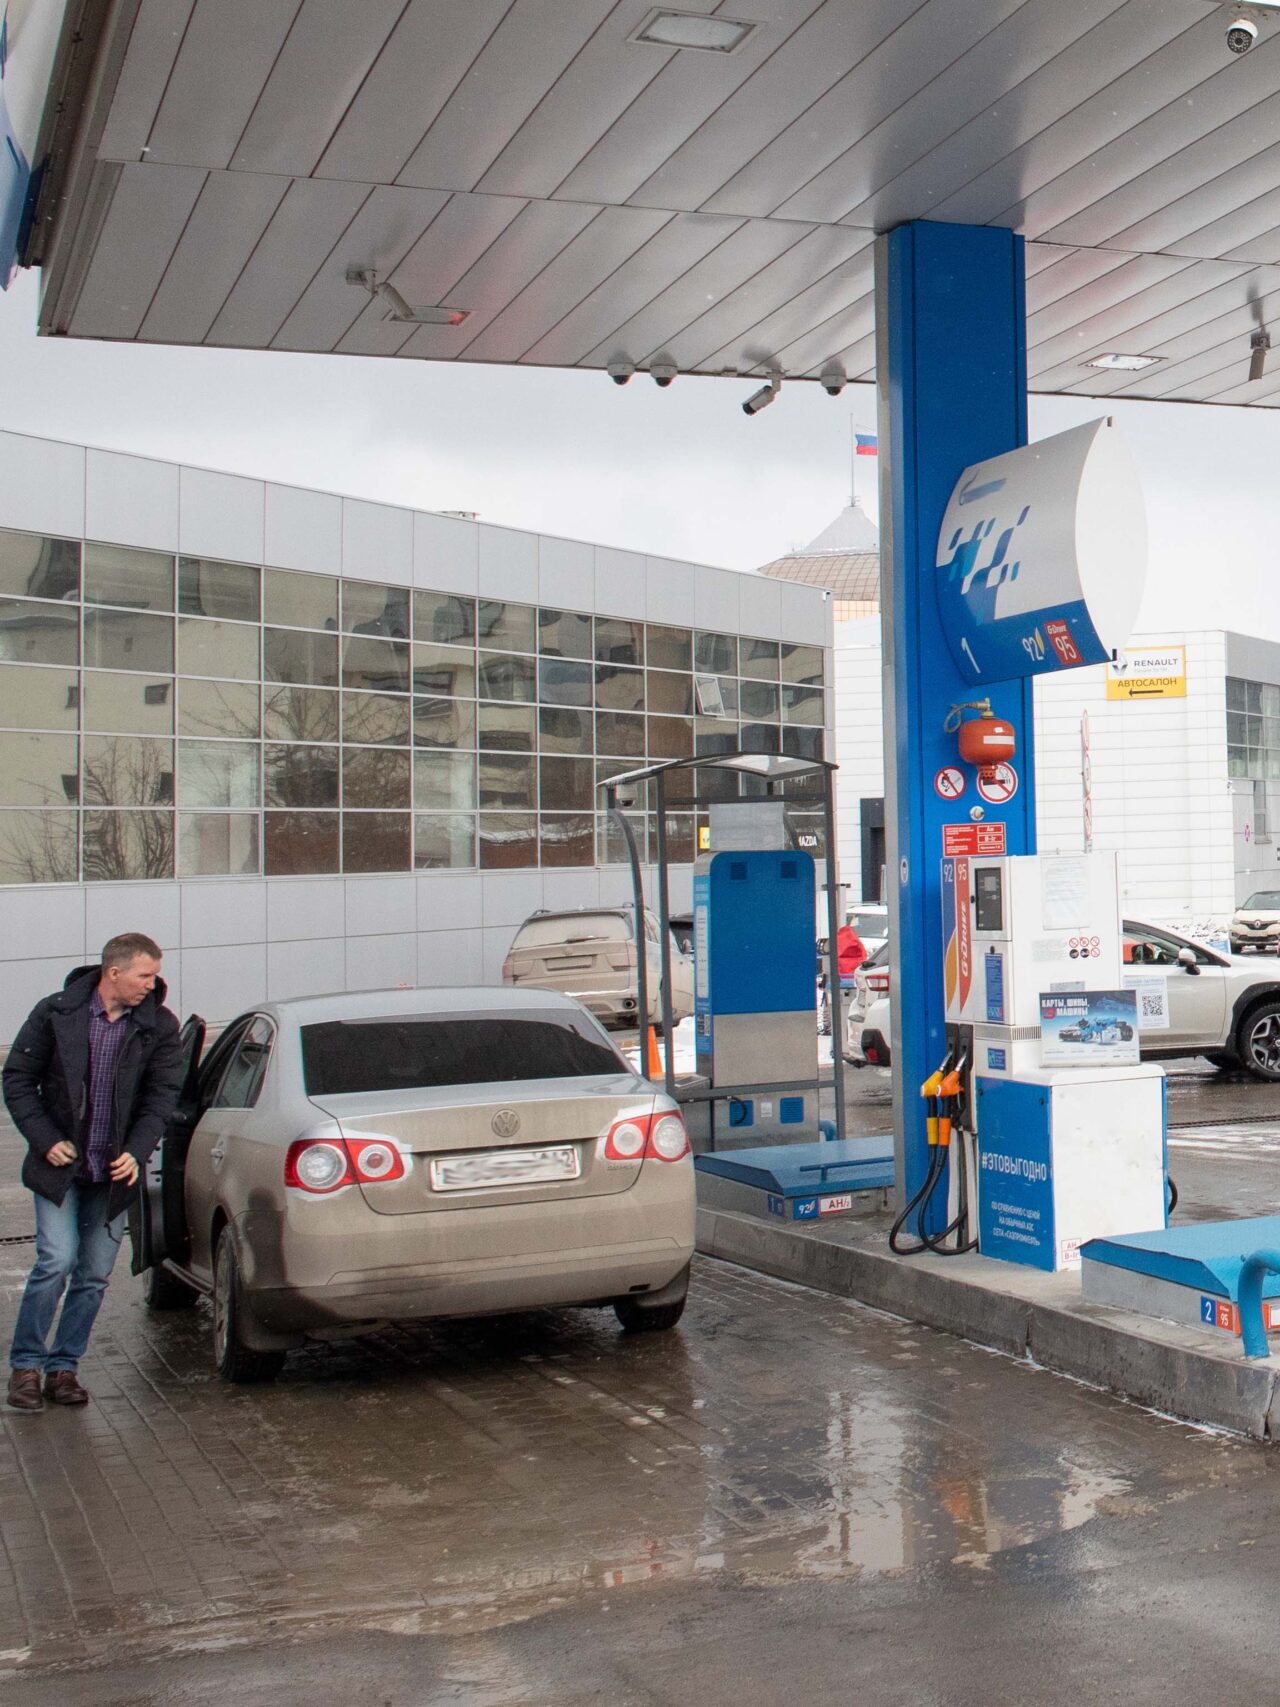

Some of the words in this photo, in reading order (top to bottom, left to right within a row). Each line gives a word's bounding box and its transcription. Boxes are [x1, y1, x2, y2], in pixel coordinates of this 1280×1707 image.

[961, 637, 981, 674] 1
[1022, 637, 1044, 662] 92
[1054, 636, 1077, 661] 95
[1134, 658, 1178, 667] RENAULT
[1117, 677, 1177, 688] АВТОСАЛОН
[943, 863, 954, 883] 92
[957, 863, 968, 881] 95
[981, 1151, 1048, 1182] #ЭТОВЫГОДНО
[798, 1204, 810, 1214] 92
[1205, 1301, 1212, 1321] 2
[1220, 1312, 1229, 1326] 95
